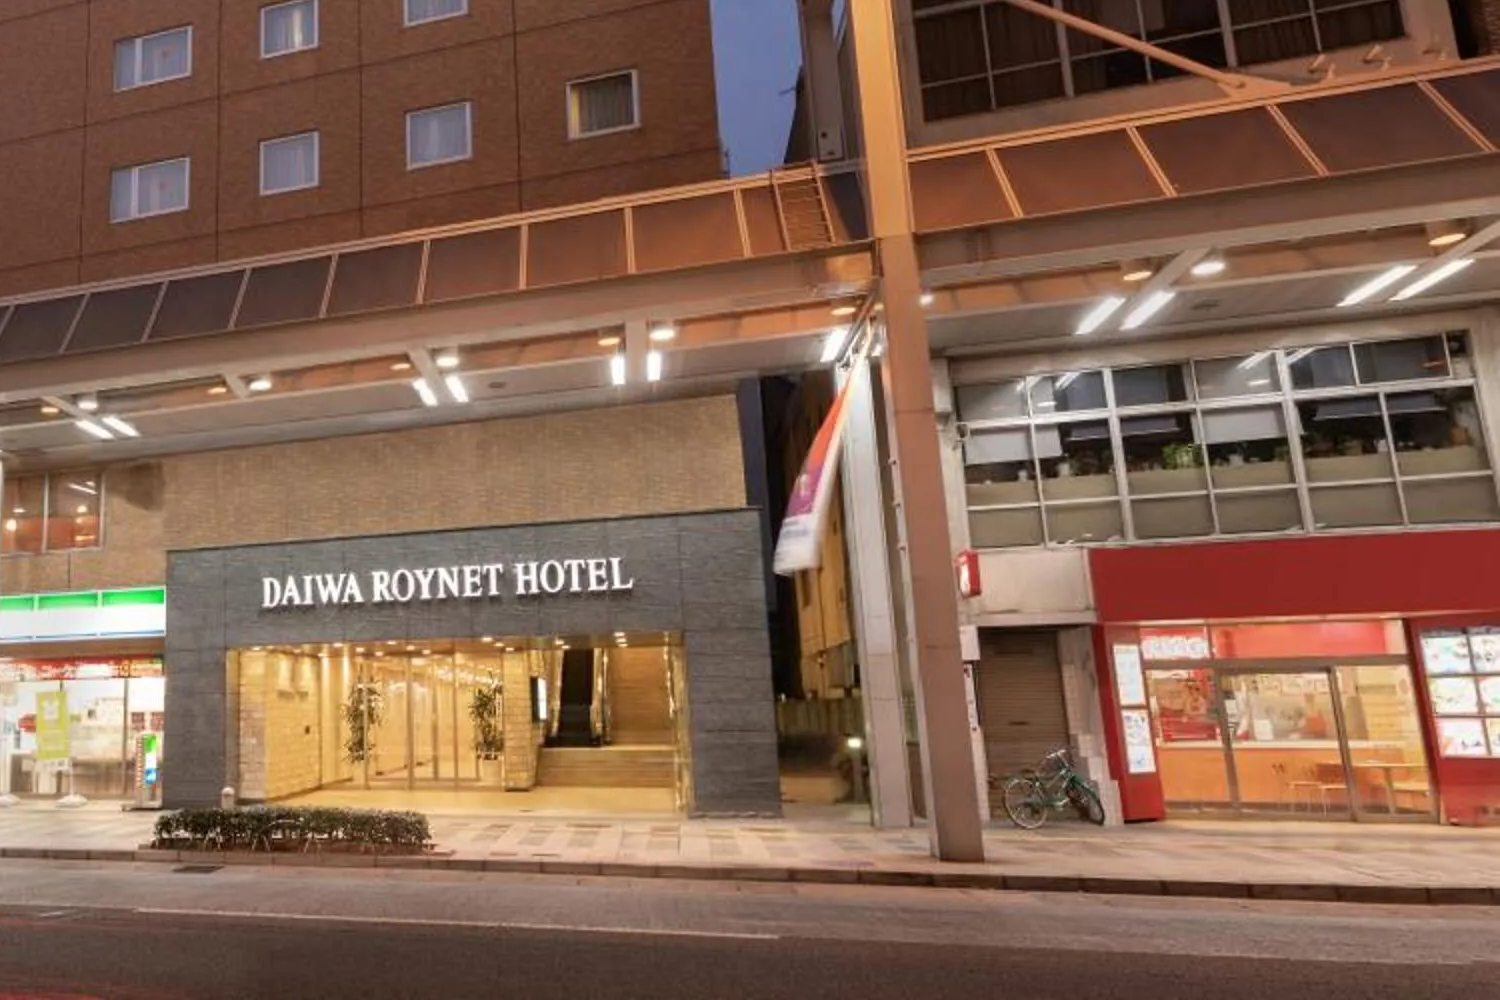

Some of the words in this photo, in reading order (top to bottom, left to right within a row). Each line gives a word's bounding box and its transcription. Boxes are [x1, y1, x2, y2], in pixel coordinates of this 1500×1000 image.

[262, 573, 363, 608] DAIWA
[372, 564, 502, 601] ROYNET
[514, 558, 634, 594] HOTEL
